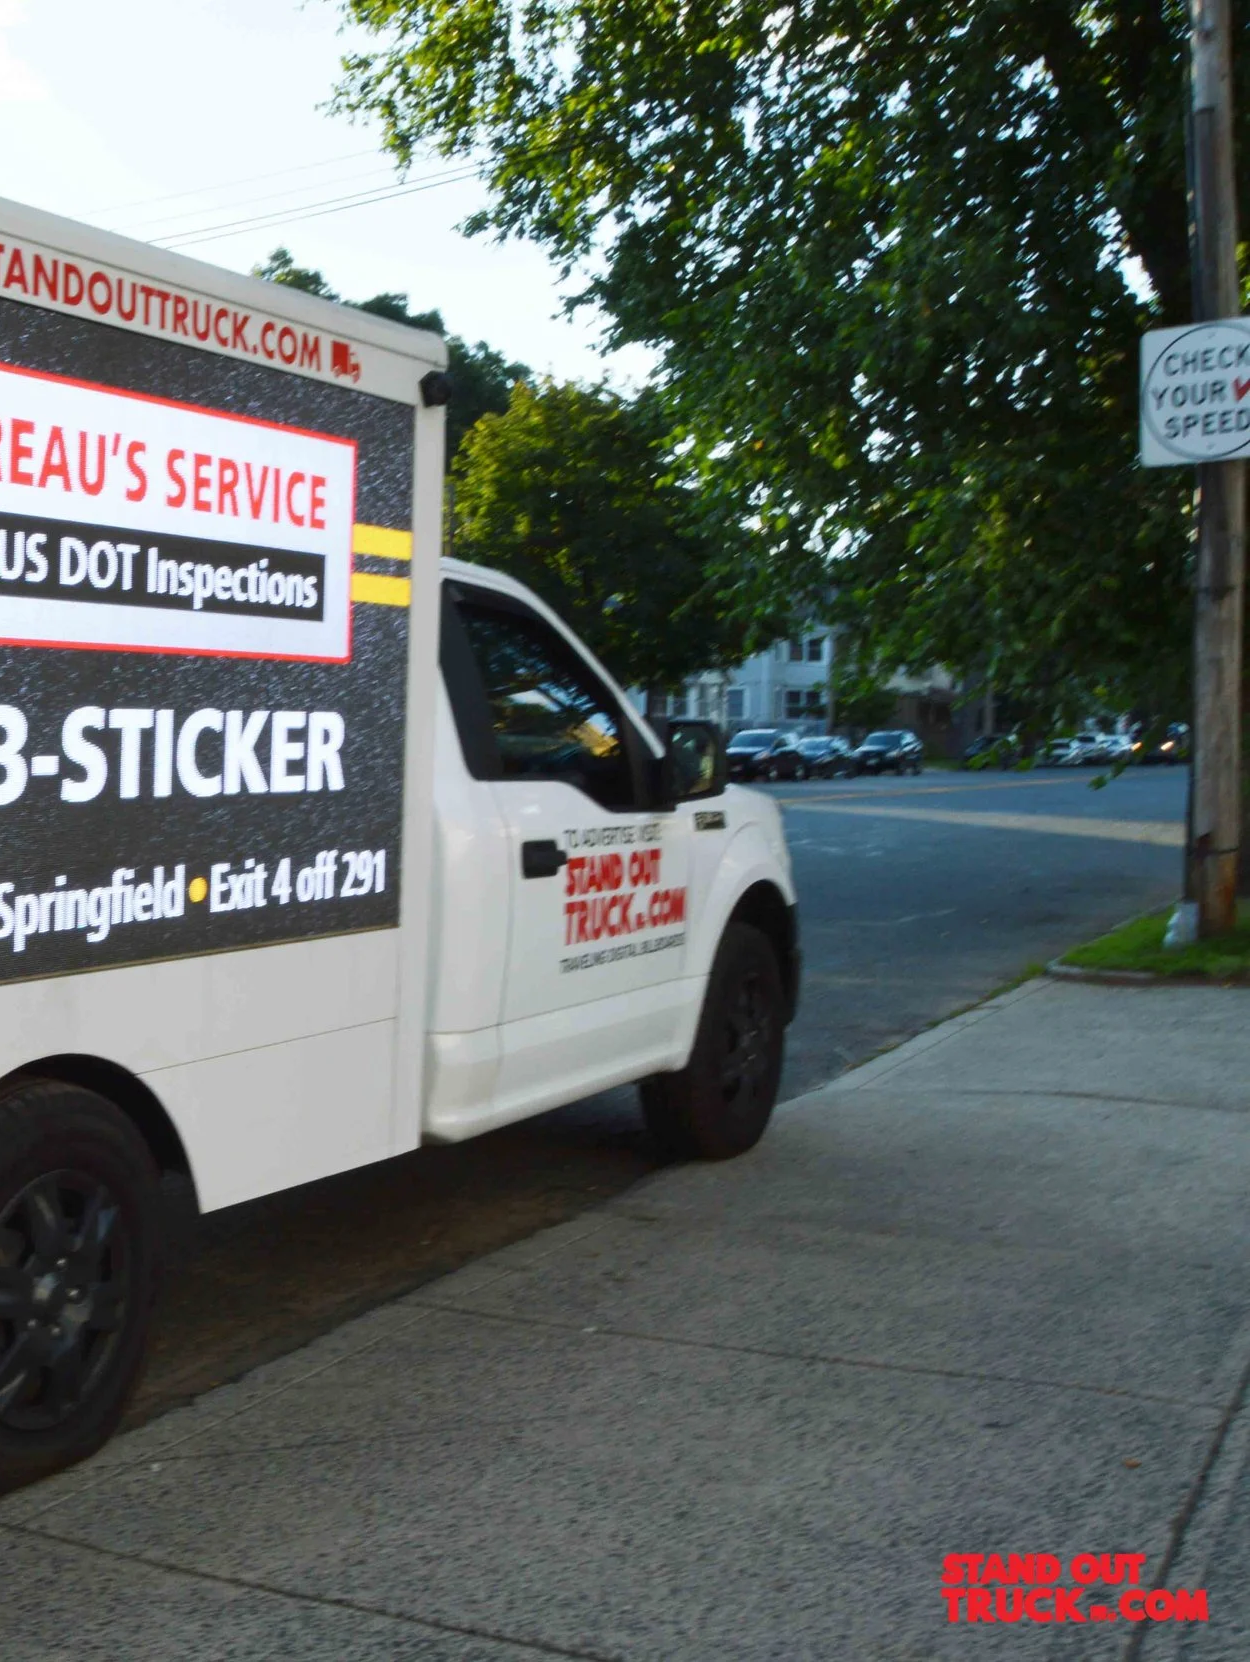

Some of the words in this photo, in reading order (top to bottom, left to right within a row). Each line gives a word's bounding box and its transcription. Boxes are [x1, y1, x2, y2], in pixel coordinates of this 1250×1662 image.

[1164, 343, 1250, 376] CHECK
[1152, 380, 1227, 411] YOUR
[1164, 407, 1250, 439] SPEED
[166, 448, 327, 530] SERVICE
[59, 537, 141, 590] DOT
[146, 547, 318, 611] Inspections
[210, 858, 267, 914] Exit
[271, 863, 291, 903] 4
[295, 851, 337, 898] off
[340, 848, 387, 894] 291
[565, 853, 623, 896] STAND
[629, 848, 662, 887] OUT
